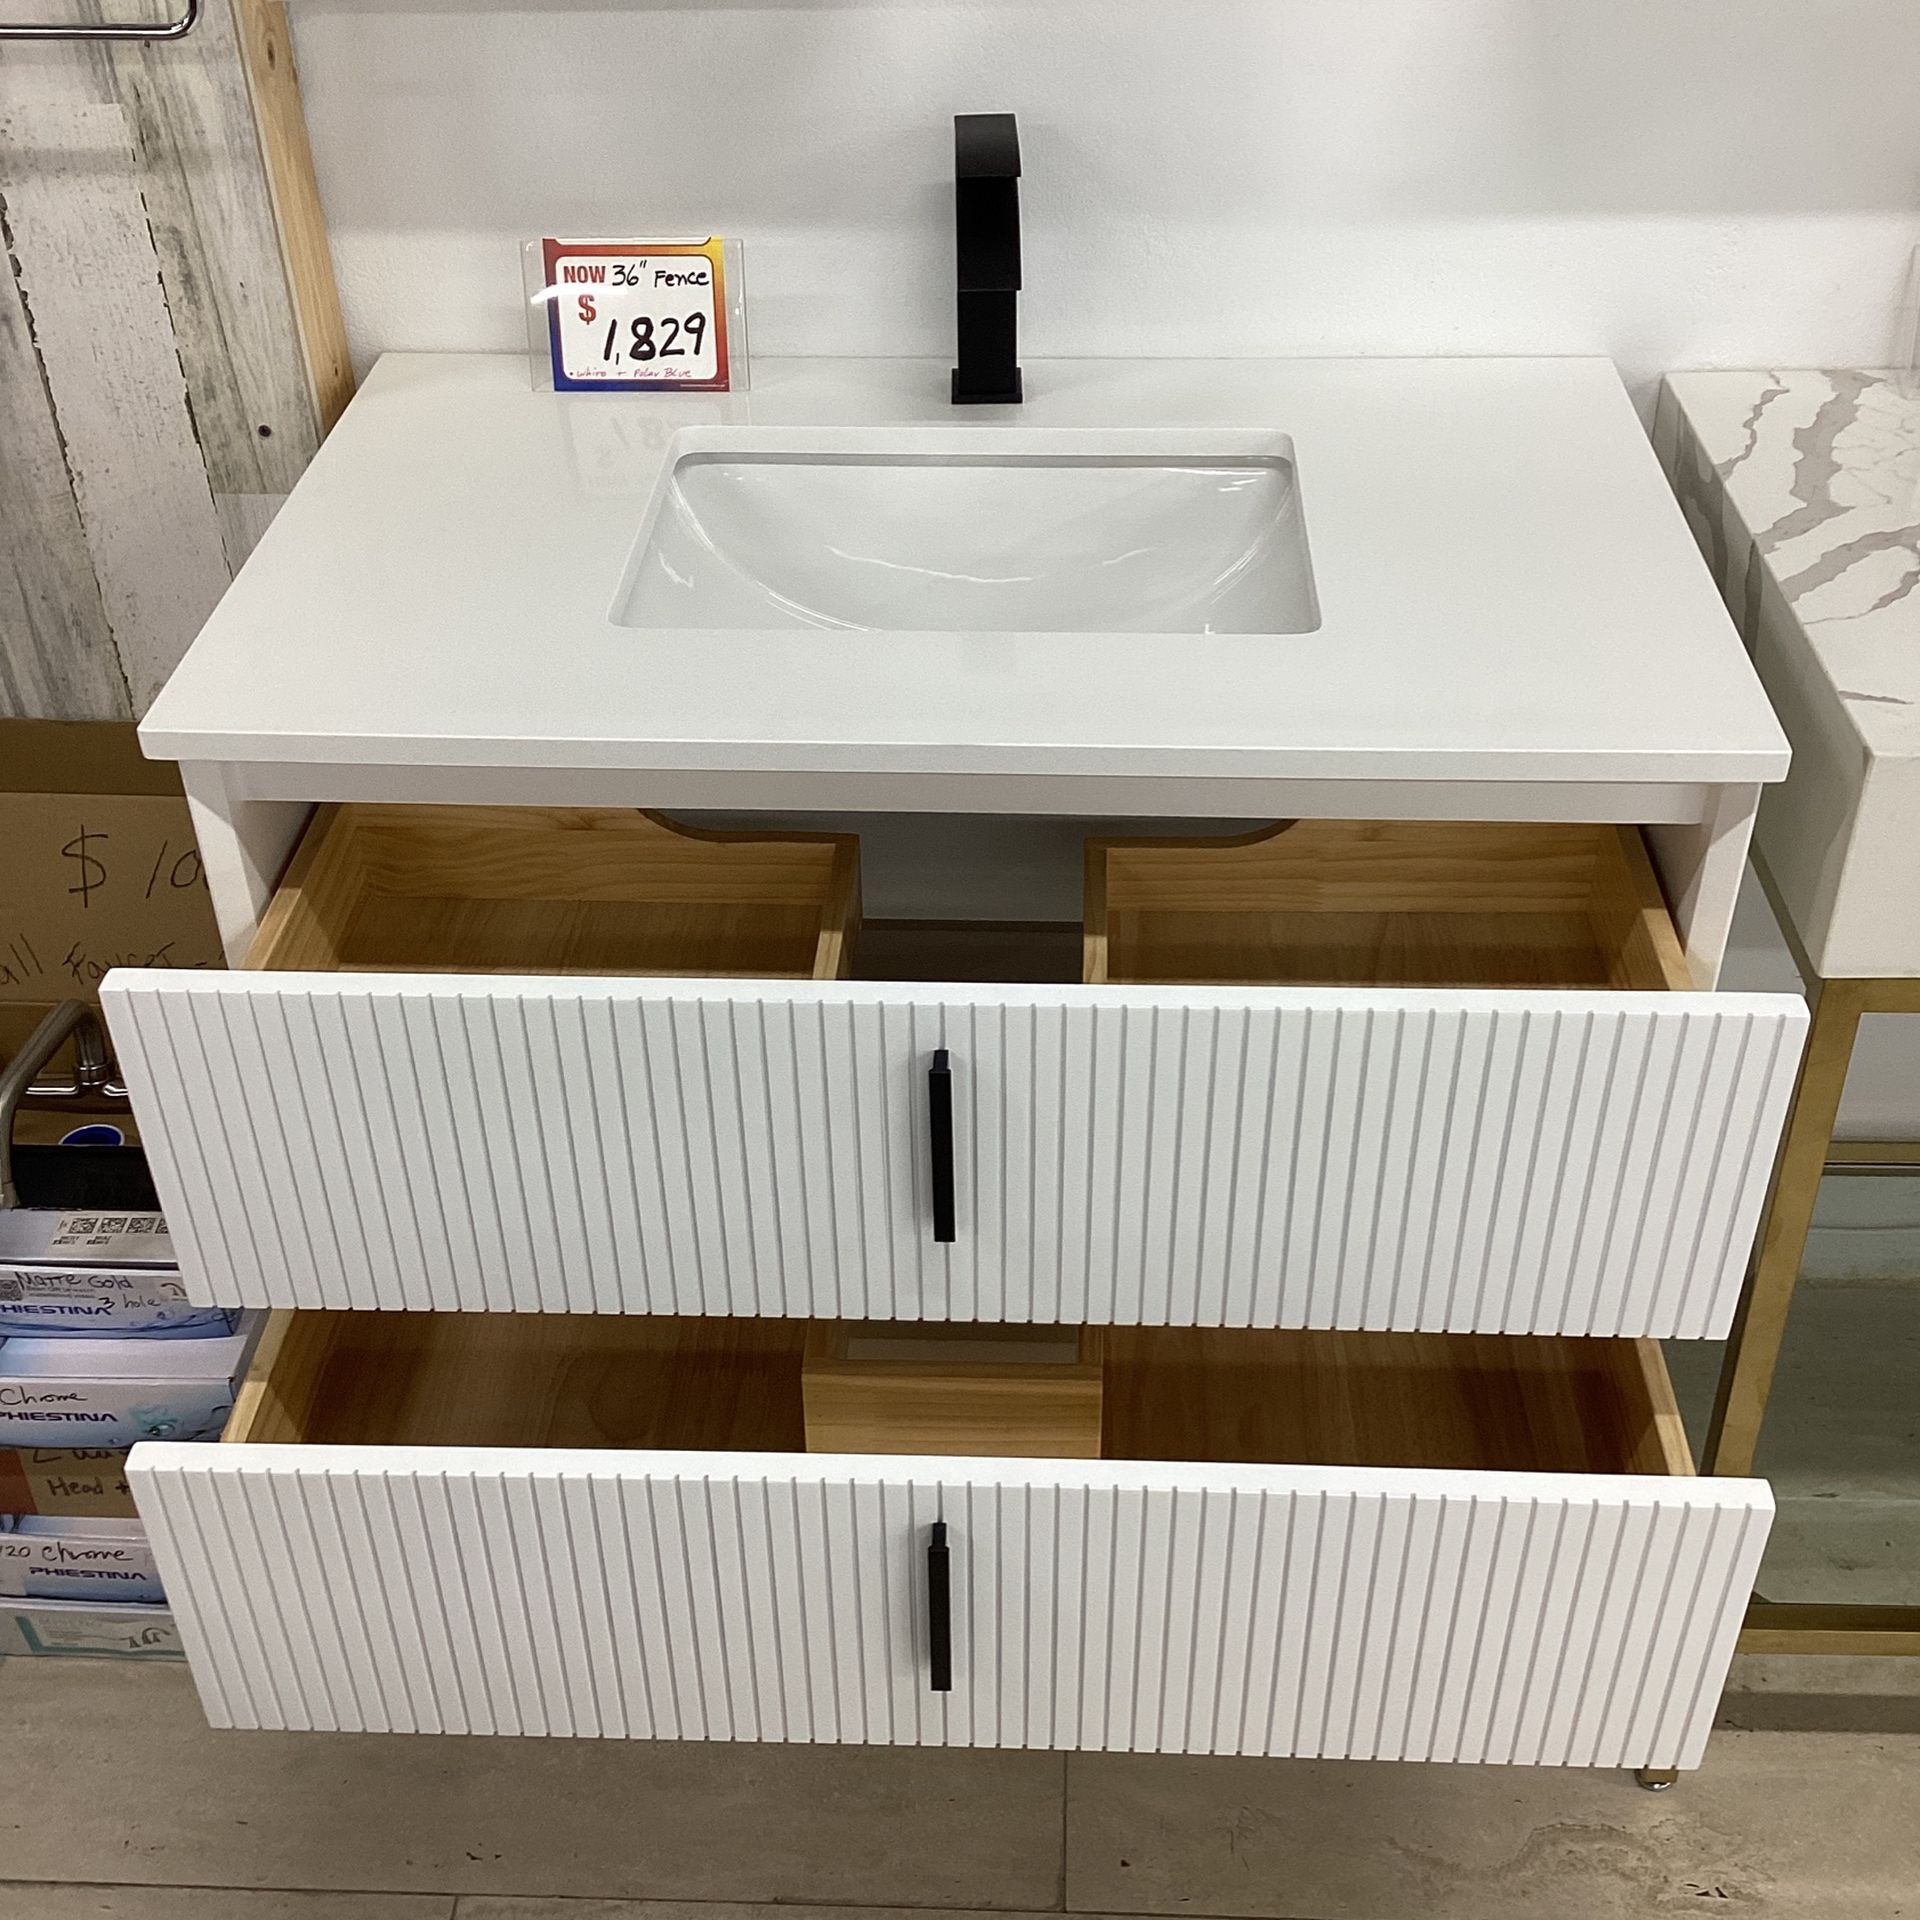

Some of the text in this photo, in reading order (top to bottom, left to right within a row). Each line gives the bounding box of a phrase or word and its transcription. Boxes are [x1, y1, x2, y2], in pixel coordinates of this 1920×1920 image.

[563, 259, 710, 288] NOW 36" Fence
[578, 294, 706, 366] $ 1,829
[61, 824, 210, 909] $ 10
[0, 1304, 112, 1316] HIESTINA
[123, 1294, 161, 1309] hole
[29, 1566, 147, 1580] PHIESTINA
